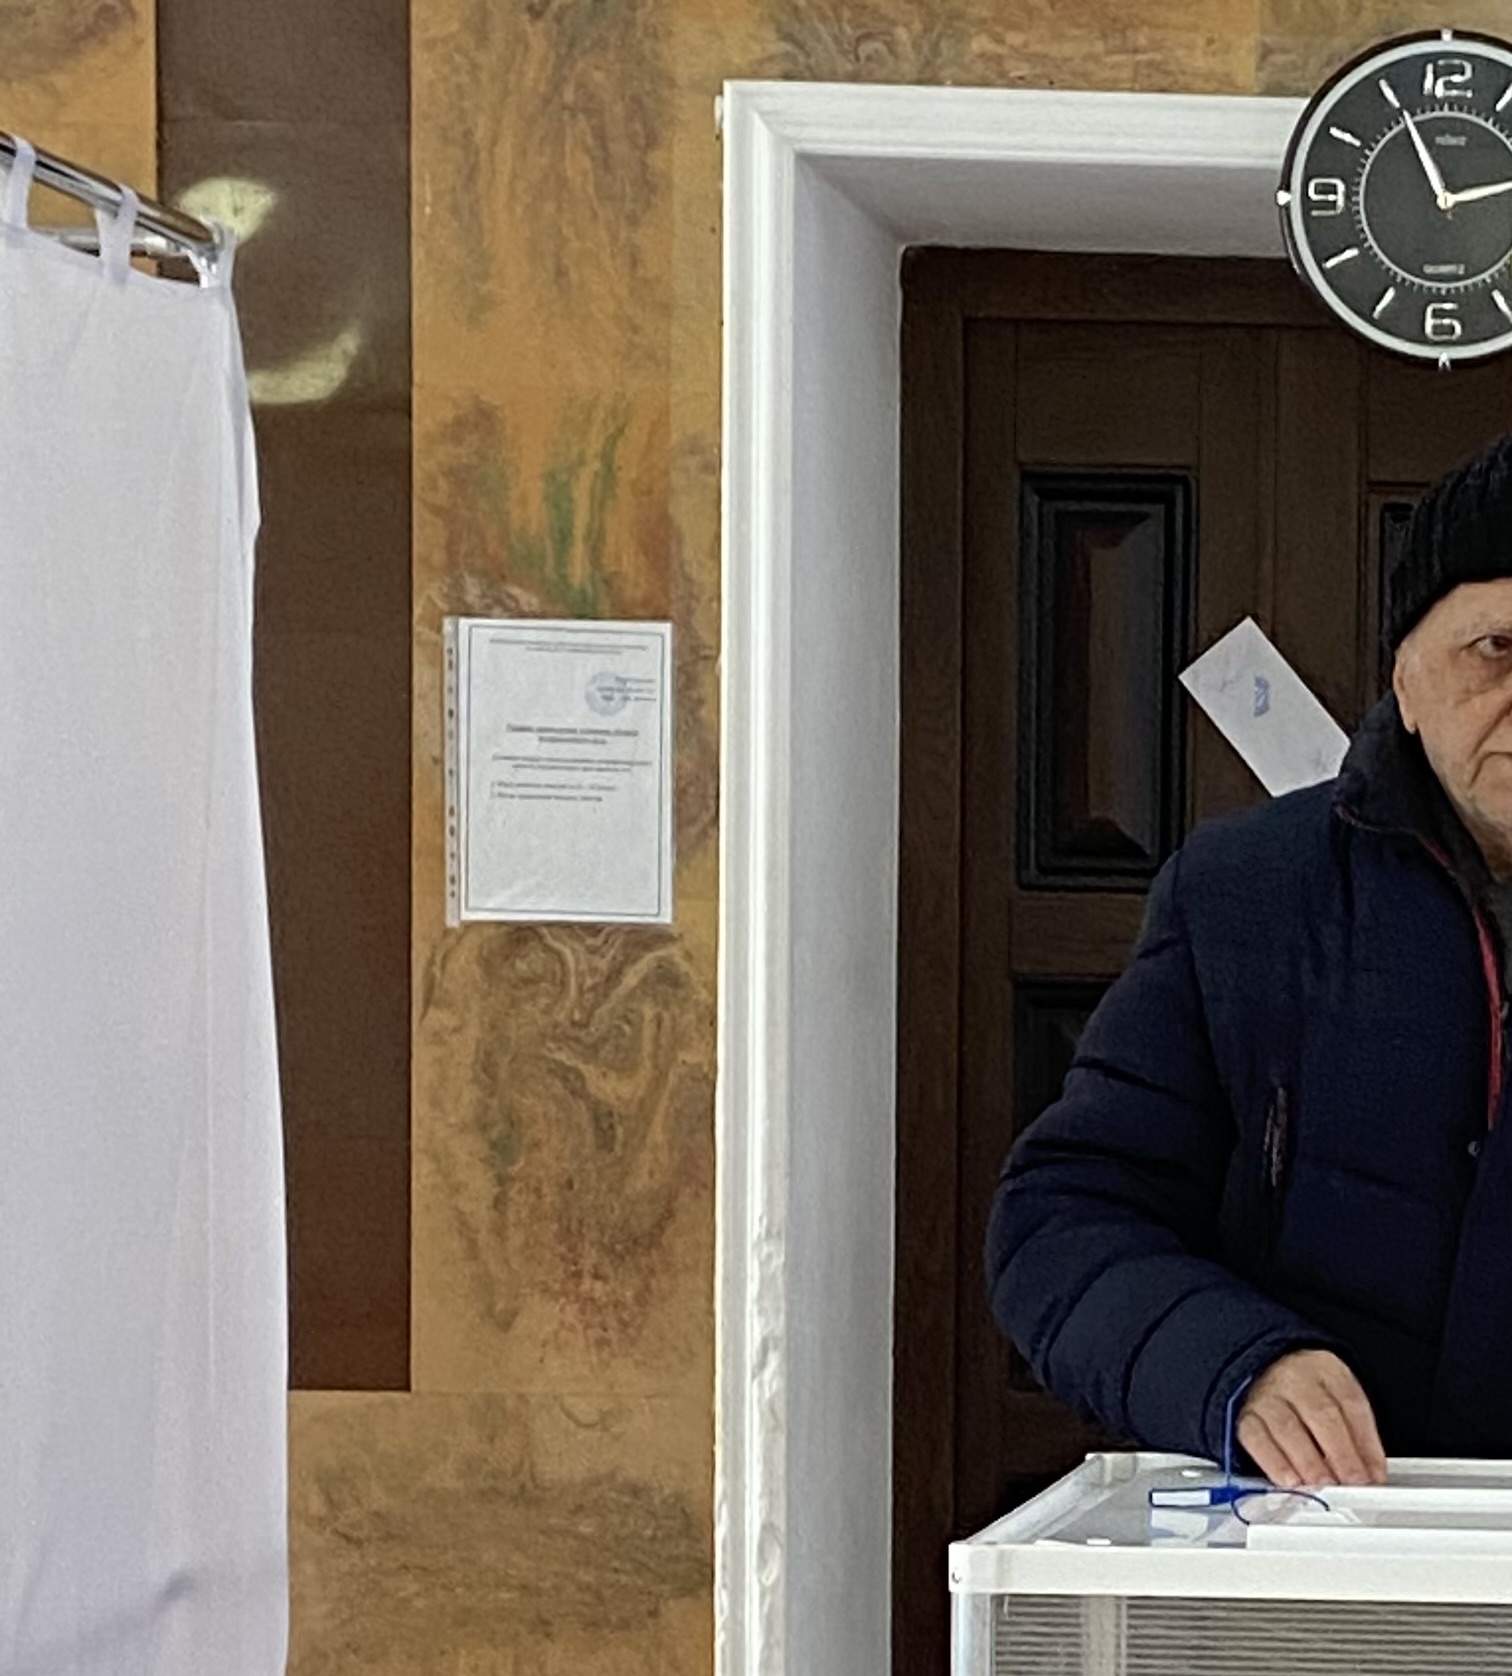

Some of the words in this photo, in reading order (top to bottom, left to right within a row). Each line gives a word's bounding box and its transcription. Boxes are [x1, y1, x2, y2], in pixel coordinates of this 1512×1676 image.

[1422, 58, 1474, 98] 12
[1307, 177, 1346, 217] 9
[1424, 302, 1463, 341] 6
